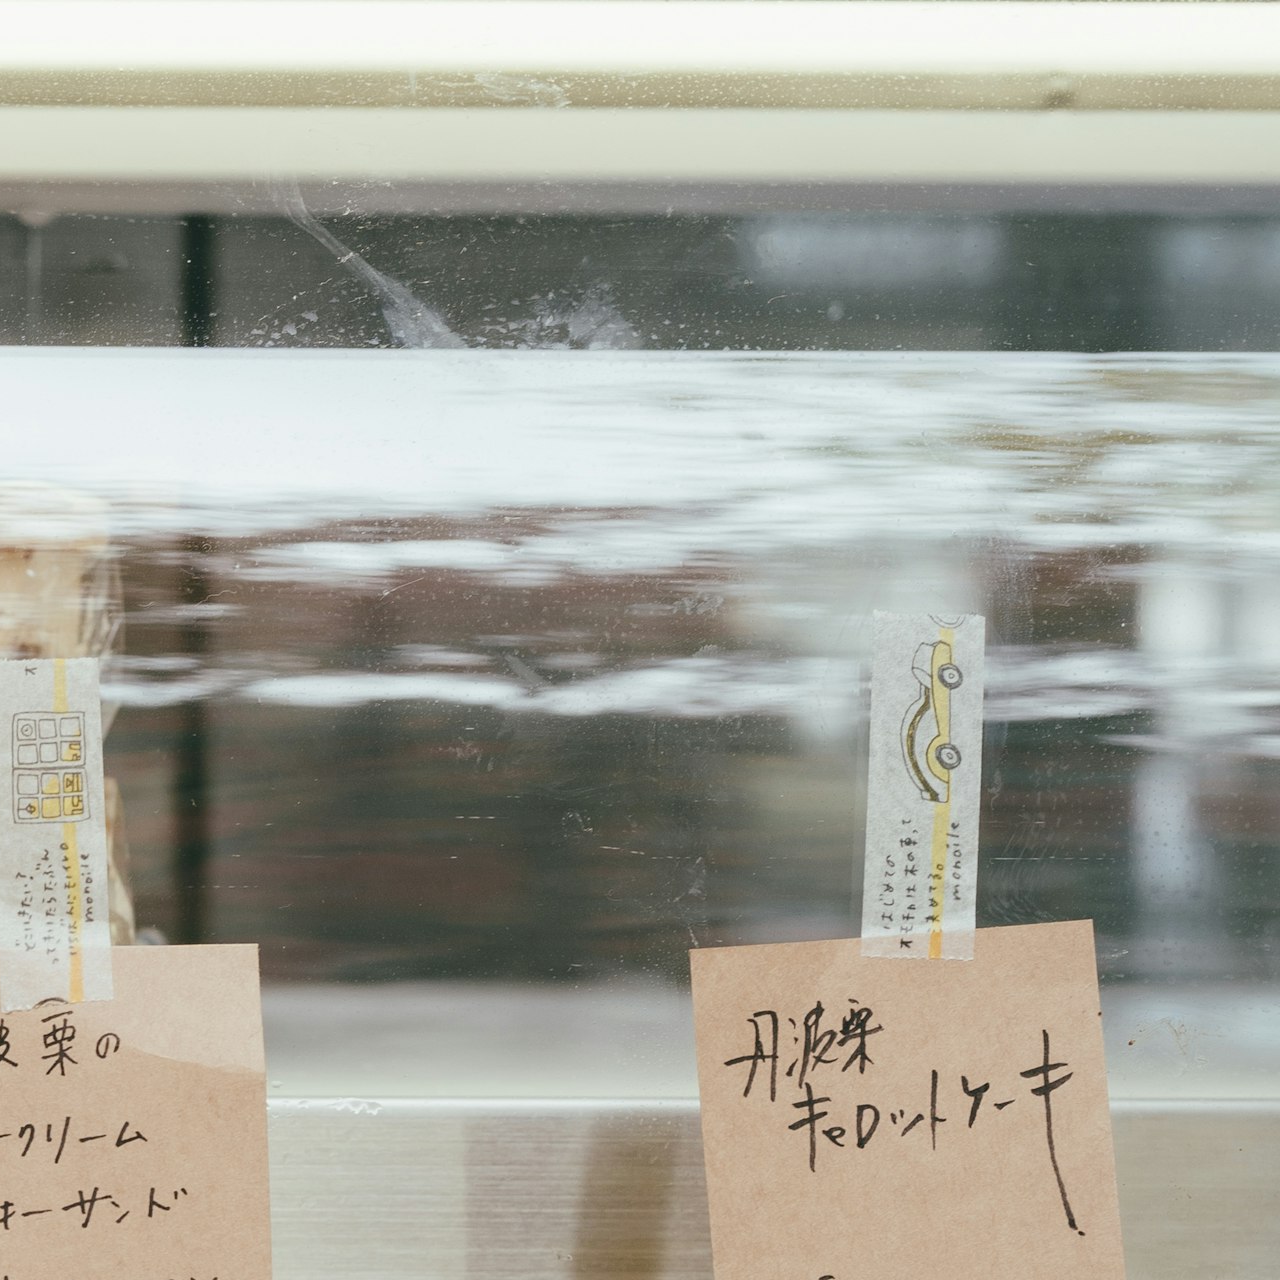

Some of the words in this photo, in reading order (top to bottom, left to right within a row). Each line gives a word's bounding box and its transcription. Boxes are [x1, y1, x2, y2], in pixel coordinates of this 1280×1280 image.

[81, 852, 95, 922] monoile
[879, 855, 896, 930] はじめての
[946, 821, 962, 900] monoile
[725, 998, 884, 1102] 丹波栗
